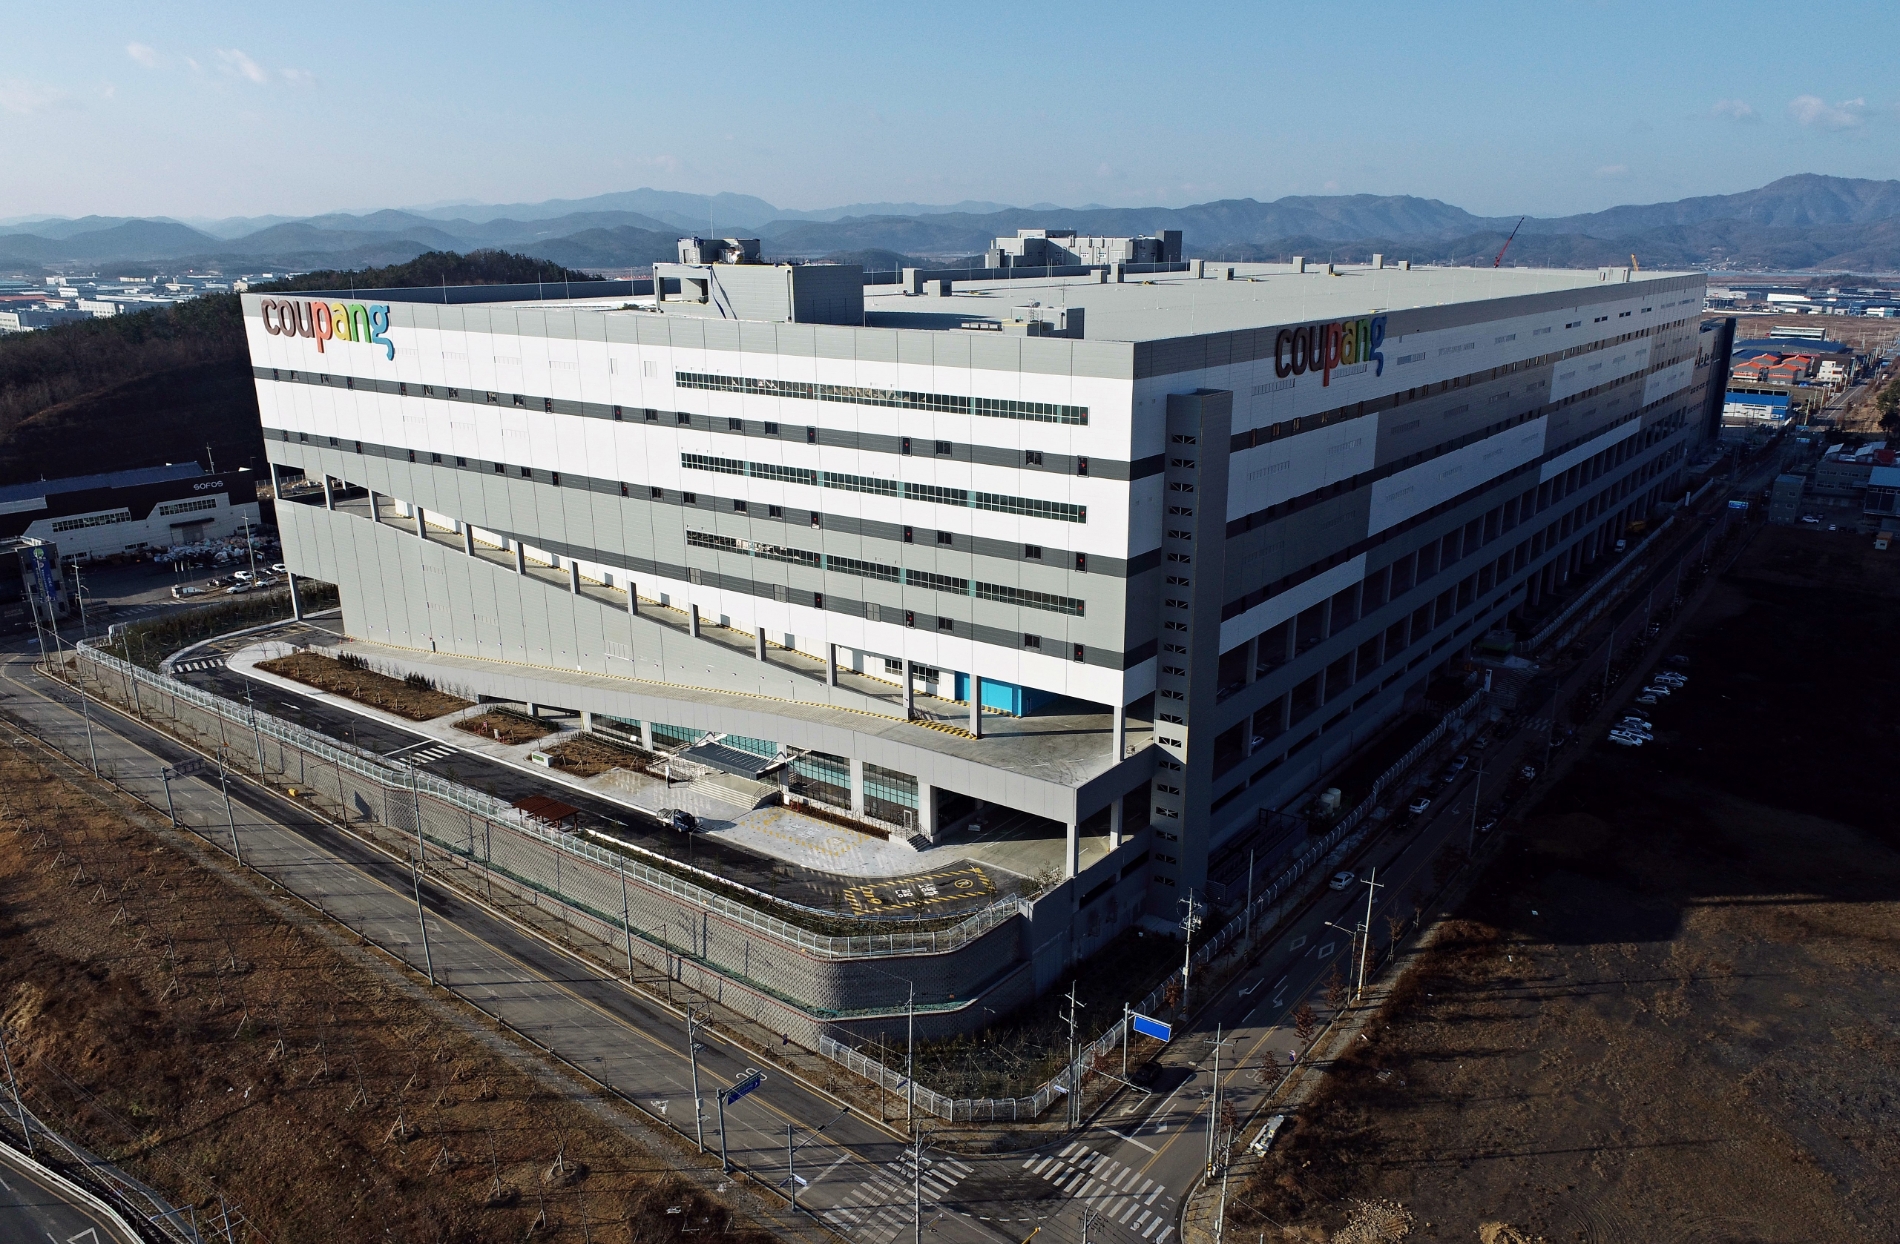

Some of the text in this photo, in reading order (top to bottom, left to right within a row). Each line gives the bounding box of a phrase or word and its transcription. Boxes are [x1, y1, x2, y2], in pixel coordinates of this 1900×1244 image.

[261, 299, 395, 361] coupang
[1276, 316, 1387, 387] coupang
[193, 480, 224, 490] SOFOS
